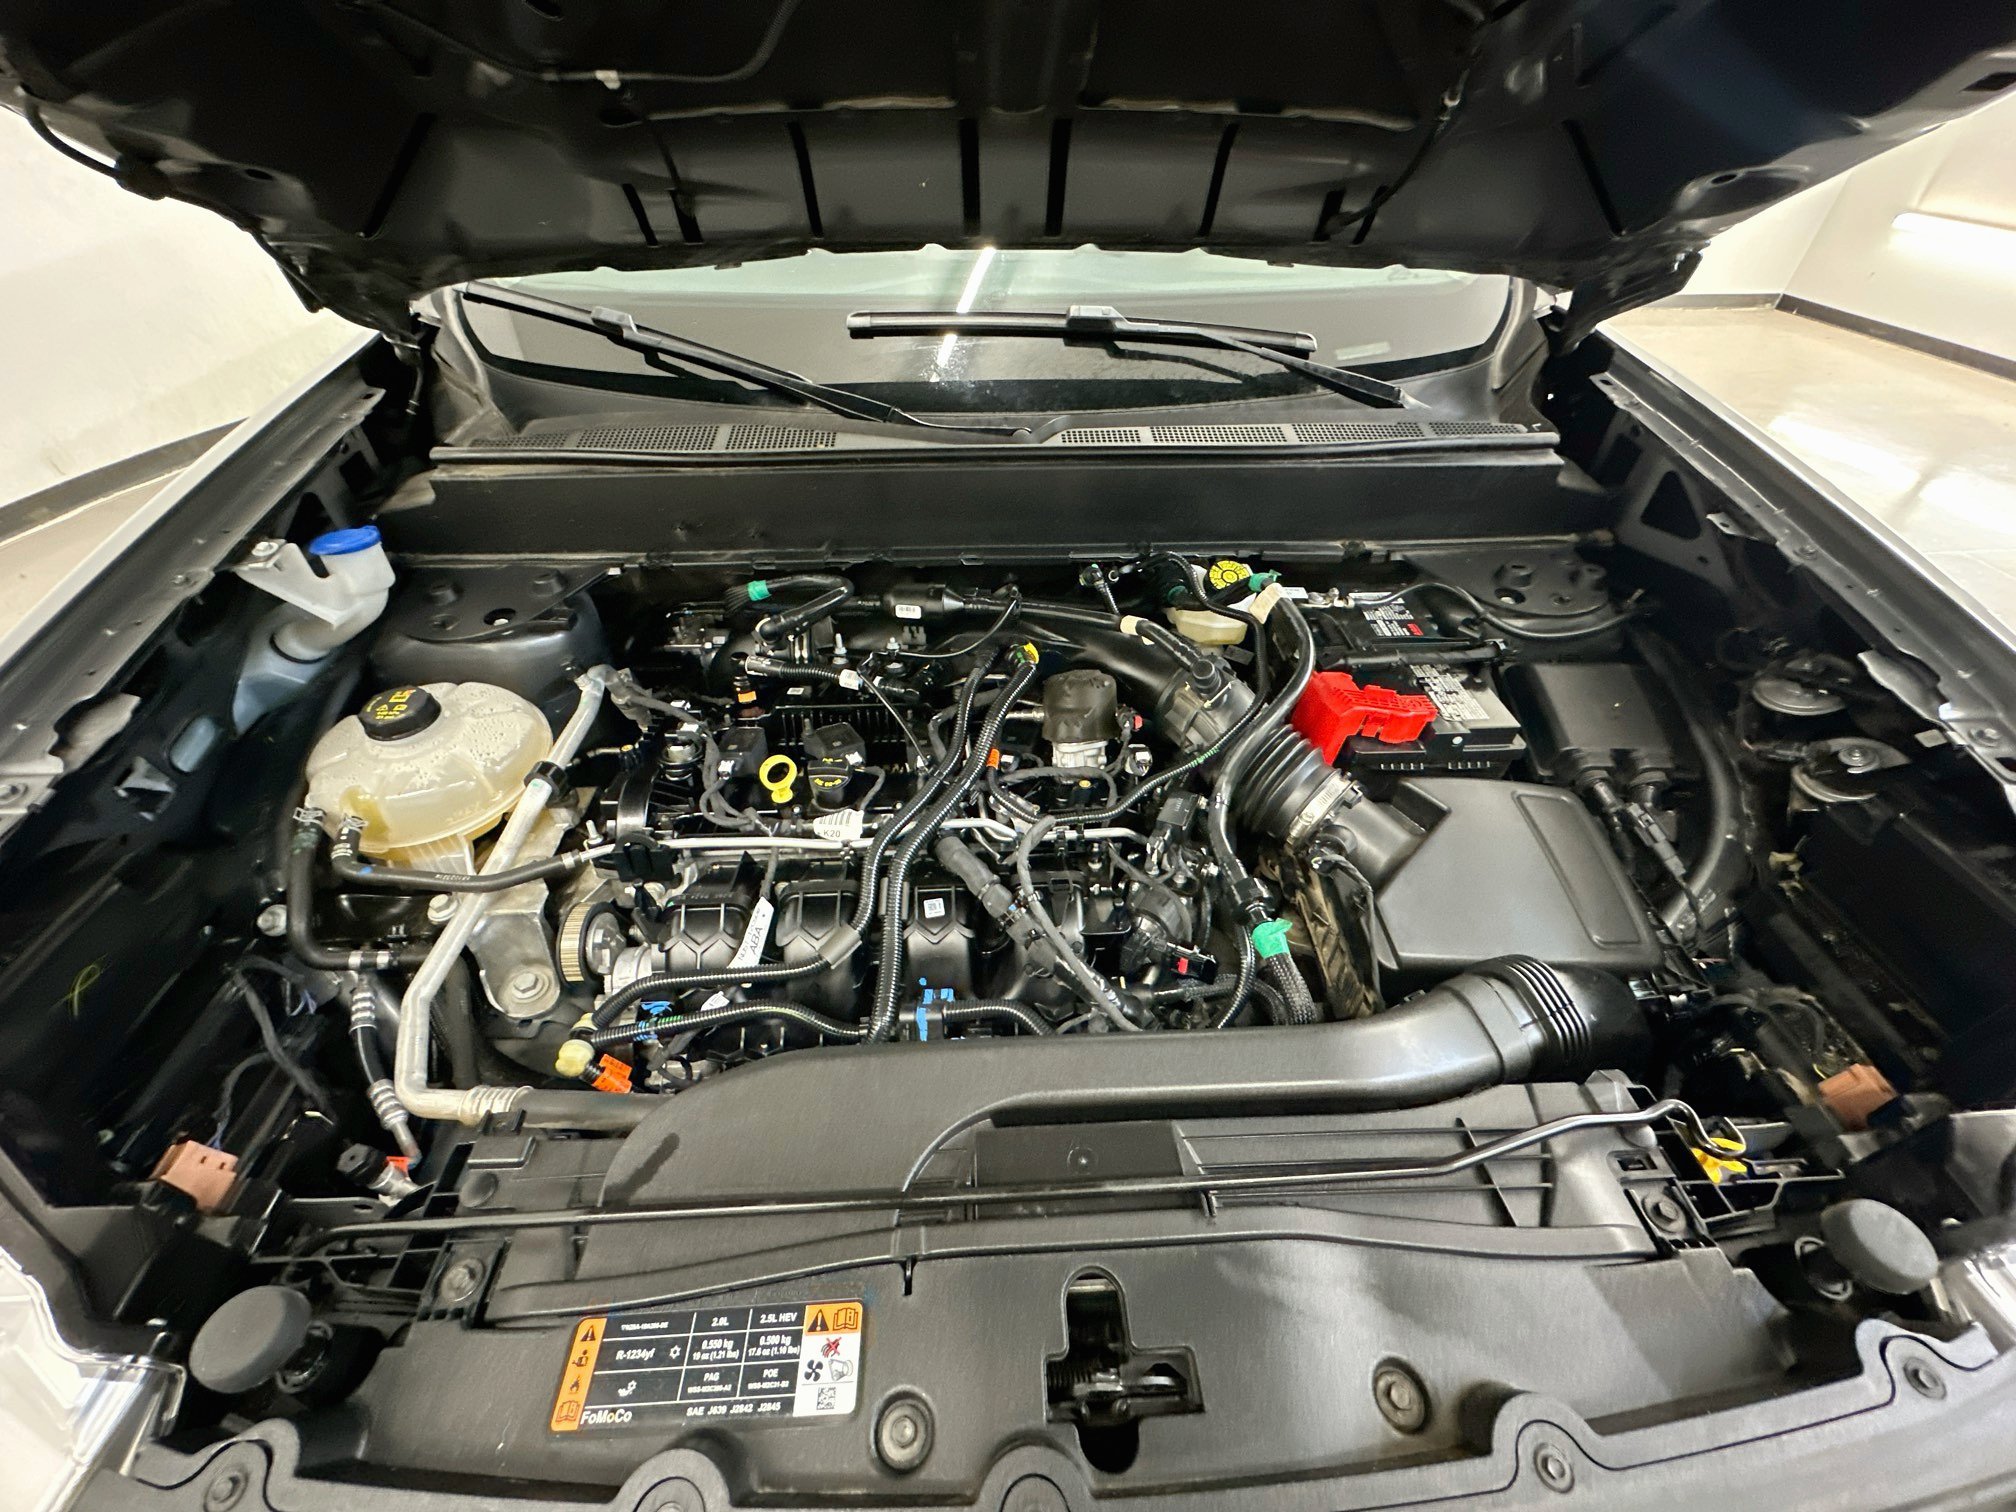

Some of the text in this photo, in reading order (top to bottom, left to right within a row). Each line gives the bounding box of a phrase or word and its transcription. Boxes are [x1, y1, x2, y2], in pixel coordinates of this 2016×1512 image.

[823, 829, 841, 838] K20
[711, 1316, 729, 1327] 2.0L
[760, 1312, 798, 1324] 2.5L HEV
[701, 1338, 734, 1350] 0.550 kg
[781, 1334, 792, 1346] kg
[615, 1347, 656, 1361] R-1234yf
[701, 1352, 709, 1360] oz
[762, 1347, 771, 1356] oz
[703, 1371, 720, 1382] PAG
[762, 1368, 779, 1379] POE
[686, 1402, 781, 1417] SAE J639 J2842 J2845
[580, 1408, 633, 1425] FoMoCo
